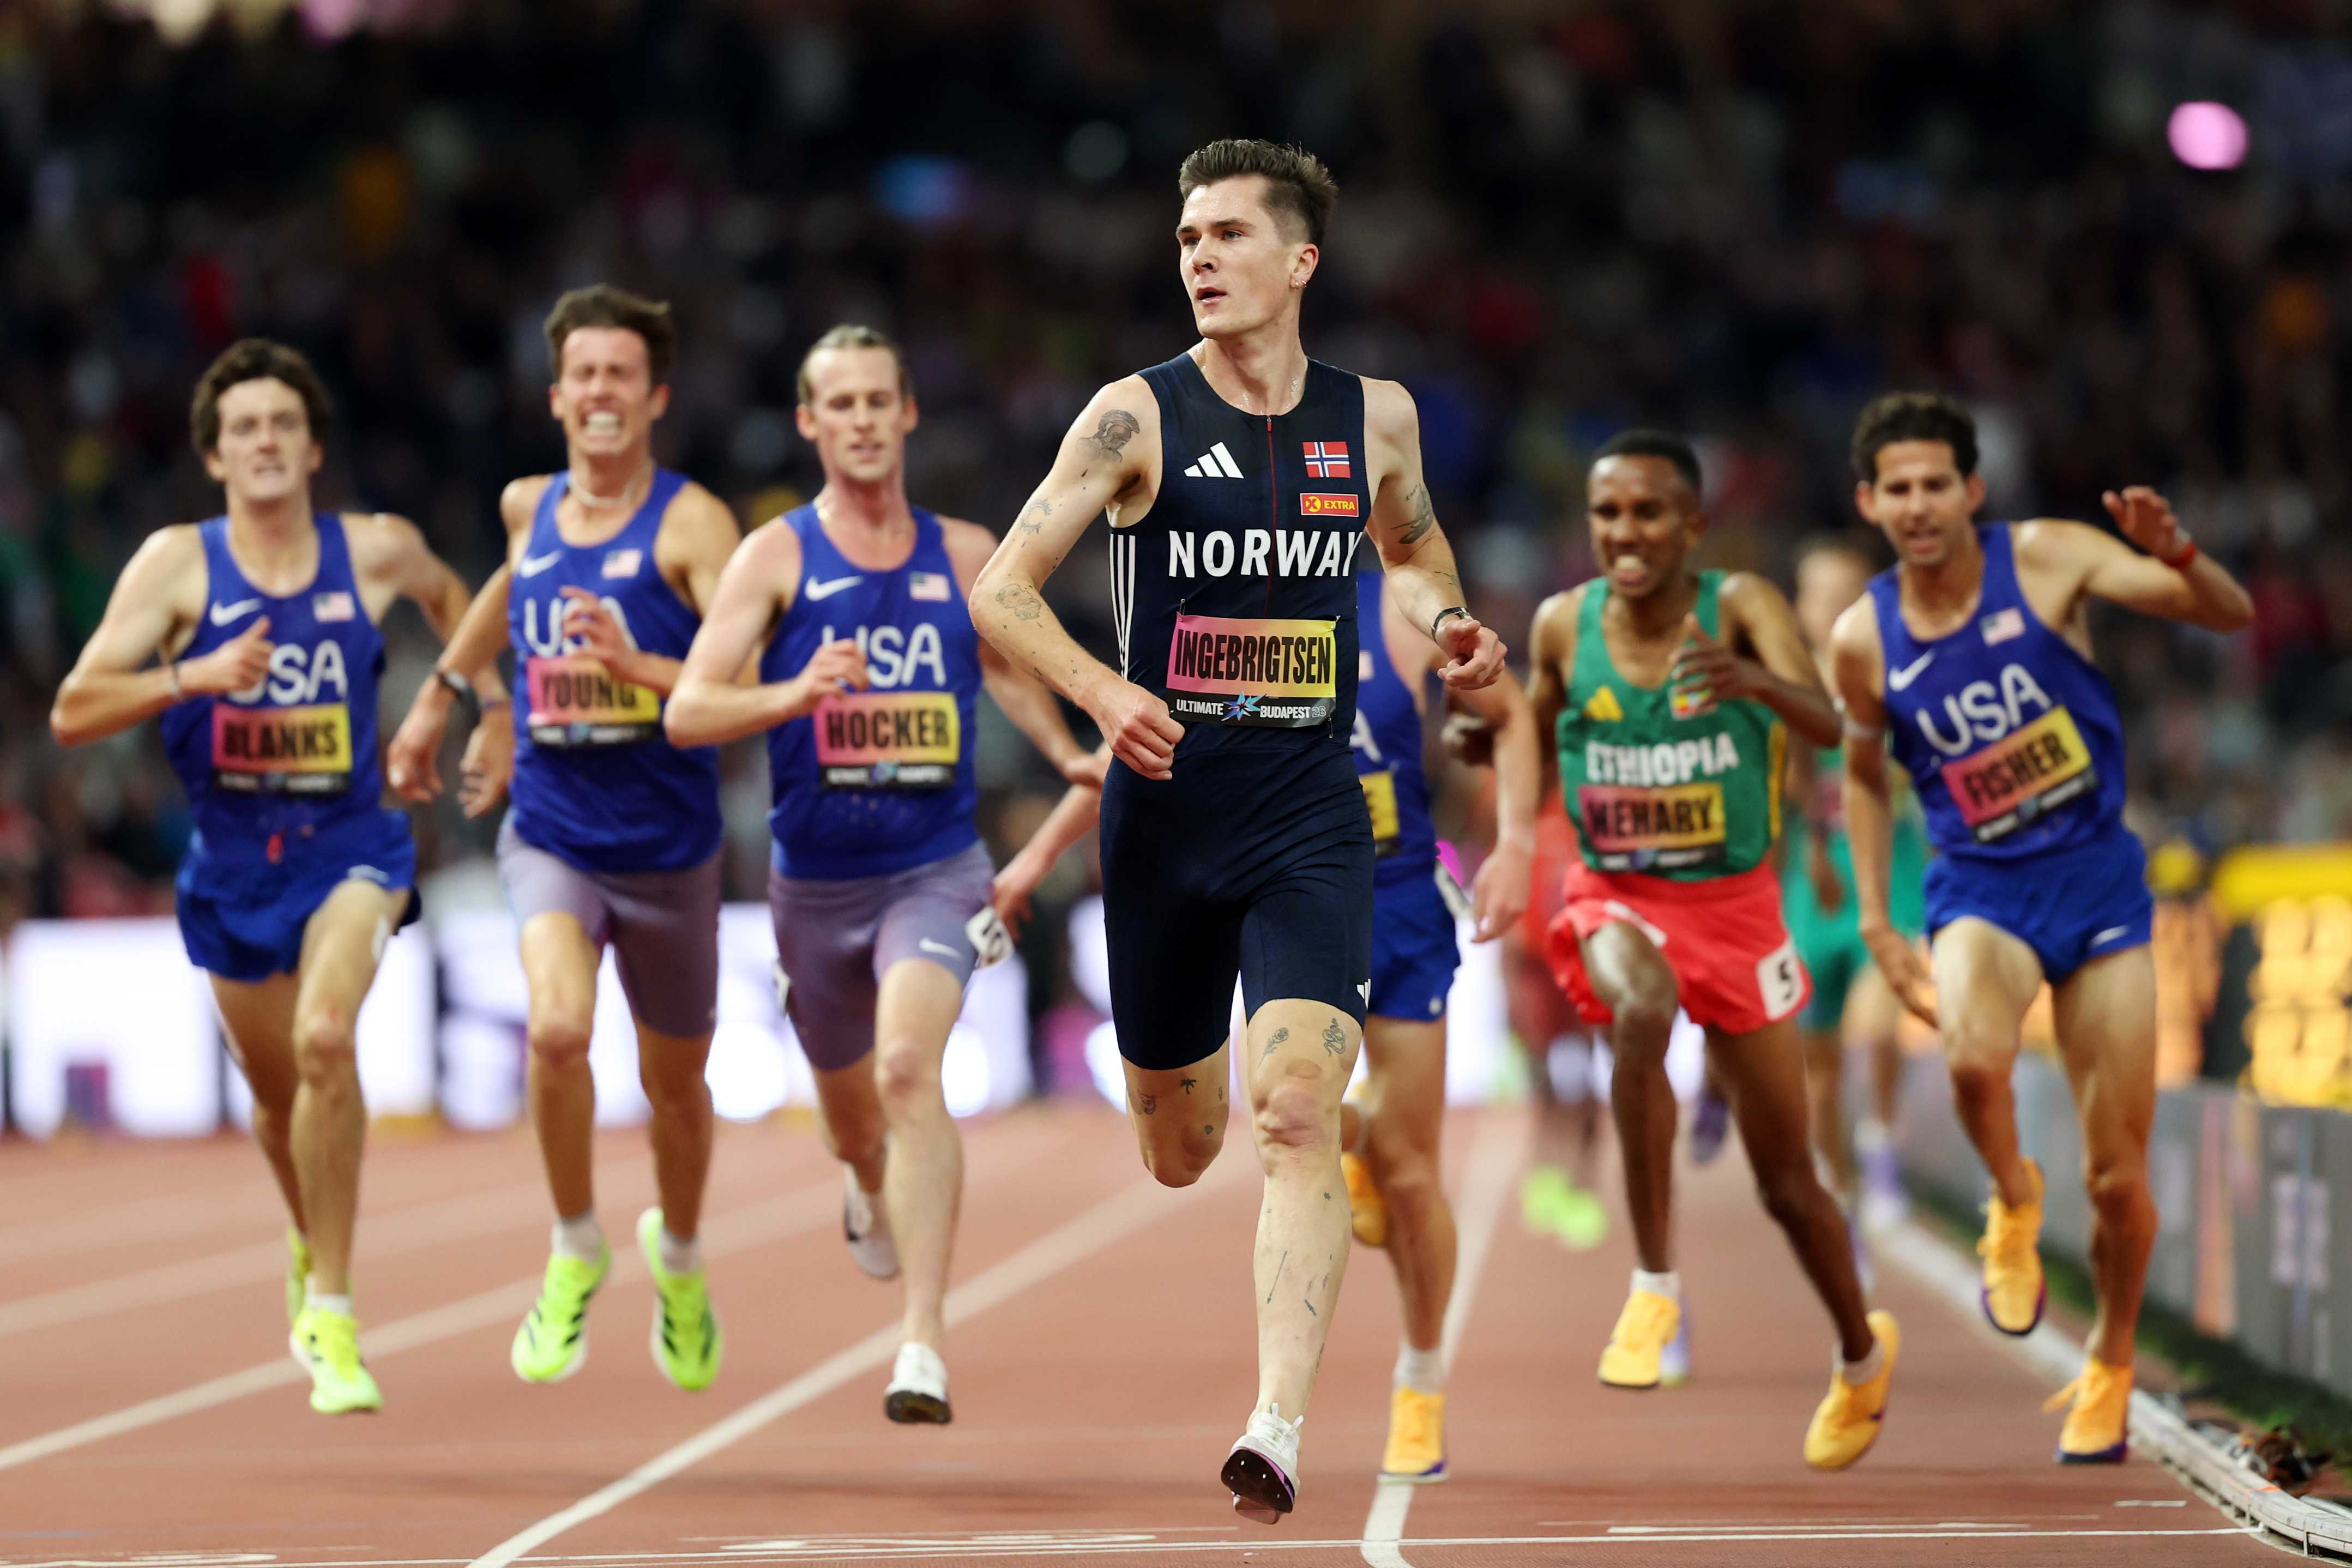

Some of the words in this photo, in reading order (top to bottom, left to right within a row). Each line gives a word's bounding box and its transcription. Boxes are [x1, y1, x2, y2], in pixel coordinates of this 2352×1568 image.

[1323, 500, 1356, 510] EXTRA
[1168, 529, 1364, 578] NORWAY
[226, 639, 348, 704] SA
[1174, 629, 1331, 684] INGEBRIGTSEN
[826, 709, 951, 749] HOCKER
[1176, 699, 1224, 715] ULTIMATE
[1259, 705, 1311, 719] BUDAPEST
[1311, 705, 1326, 718] 26
[1915, 663, 2052, 756] USA
[224, 722, 337, 759] BLANKS
[1585, 732, 1740, 787] ETHIOPIA
[1964, 732, 2070, 809] FISHER
